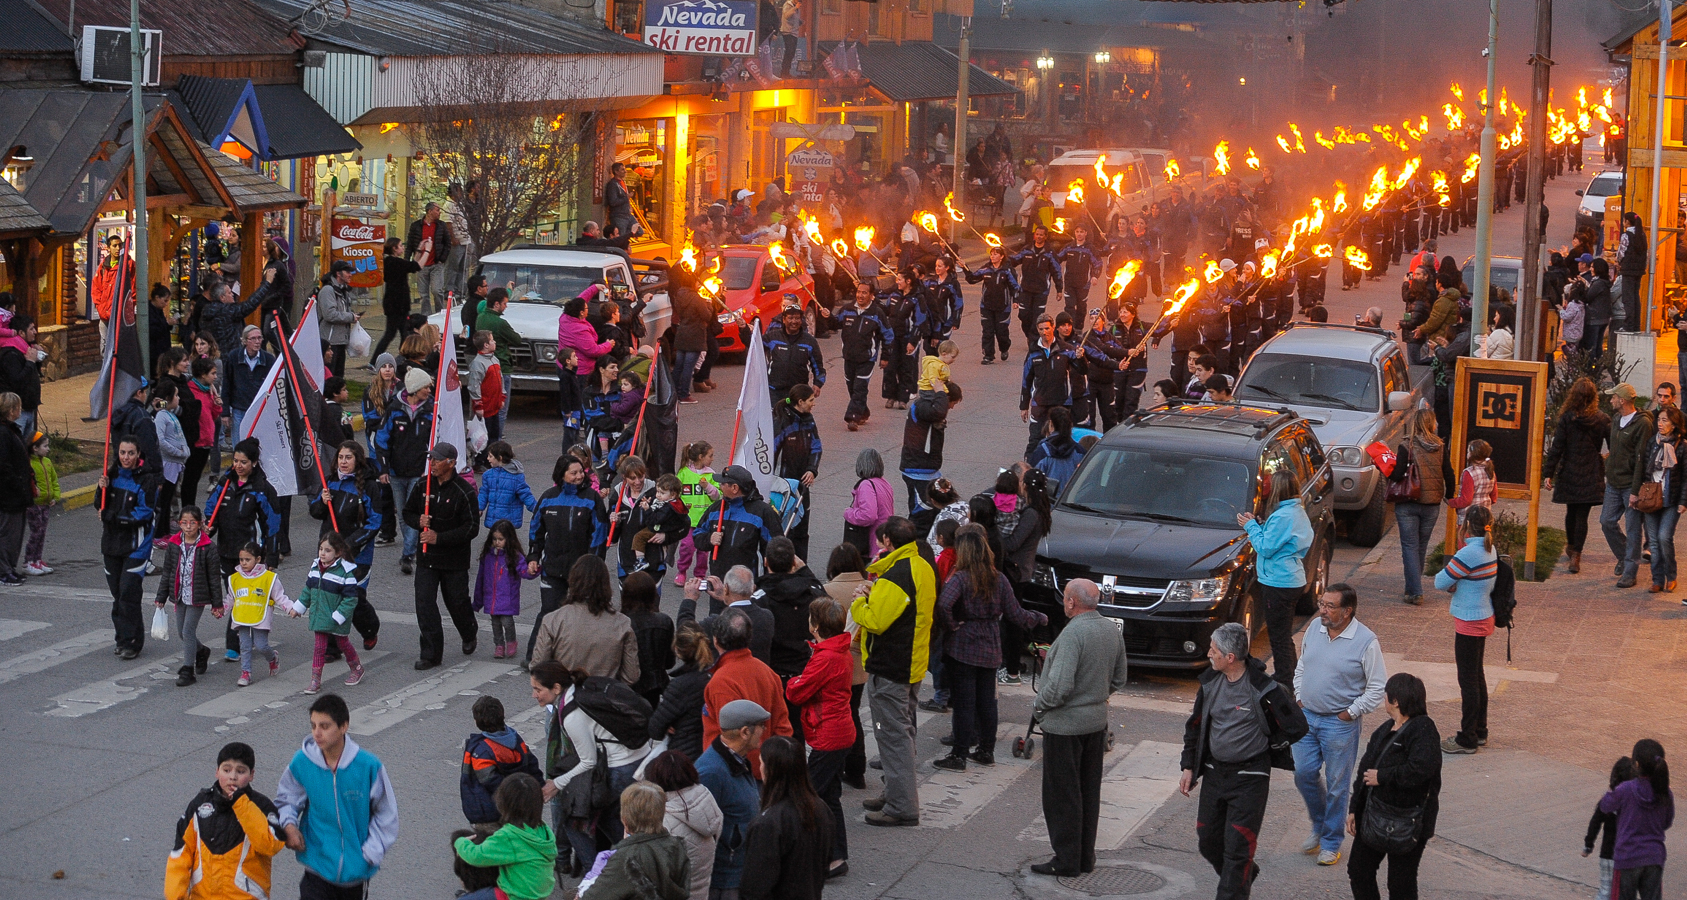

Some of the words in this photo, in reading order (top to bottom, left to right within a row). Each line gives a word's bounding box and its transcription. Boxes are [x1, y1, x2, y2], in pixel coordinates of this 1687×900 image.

[657, 6, 746, 26] Nevada
[649, 28, 680, 50] ski
[685, 31, 754, 53] rental
[790, 155, 832, 166] Nevada
[801, 182, 818, 193] ski
[344, 195, 375, 205] ABIERTO
[804, 193, 823, 202] nta
[342, 247, 374, 257] Kiosco
[346, 256, 378, 275] UE
